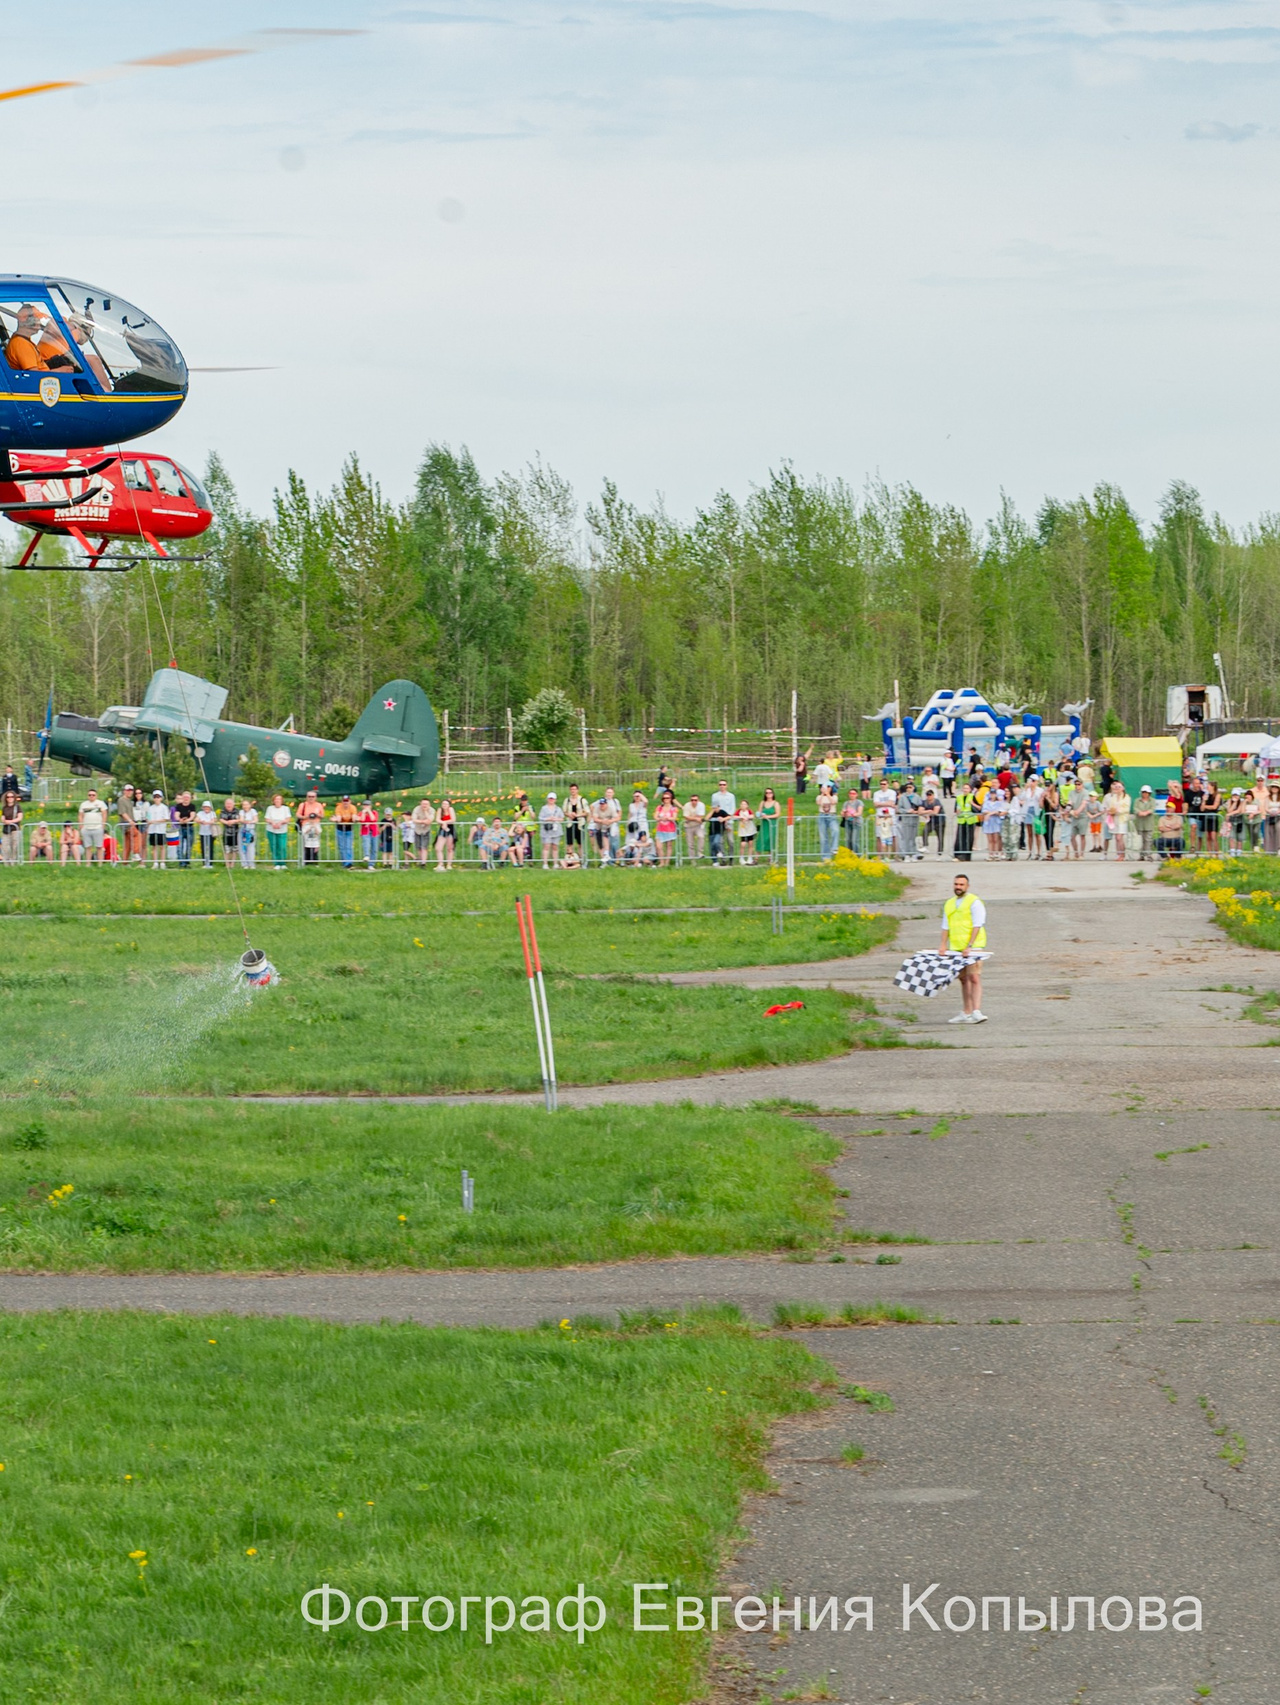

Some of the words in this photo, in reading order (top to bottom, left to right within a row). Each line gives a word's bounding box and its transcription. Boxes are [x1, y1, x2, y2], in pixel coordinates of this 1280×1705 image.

[54, 507, 110, 518] ЖИЗНИ
[293, 759, 312, 771] RF
[325, 763, 360, 777] 00416
